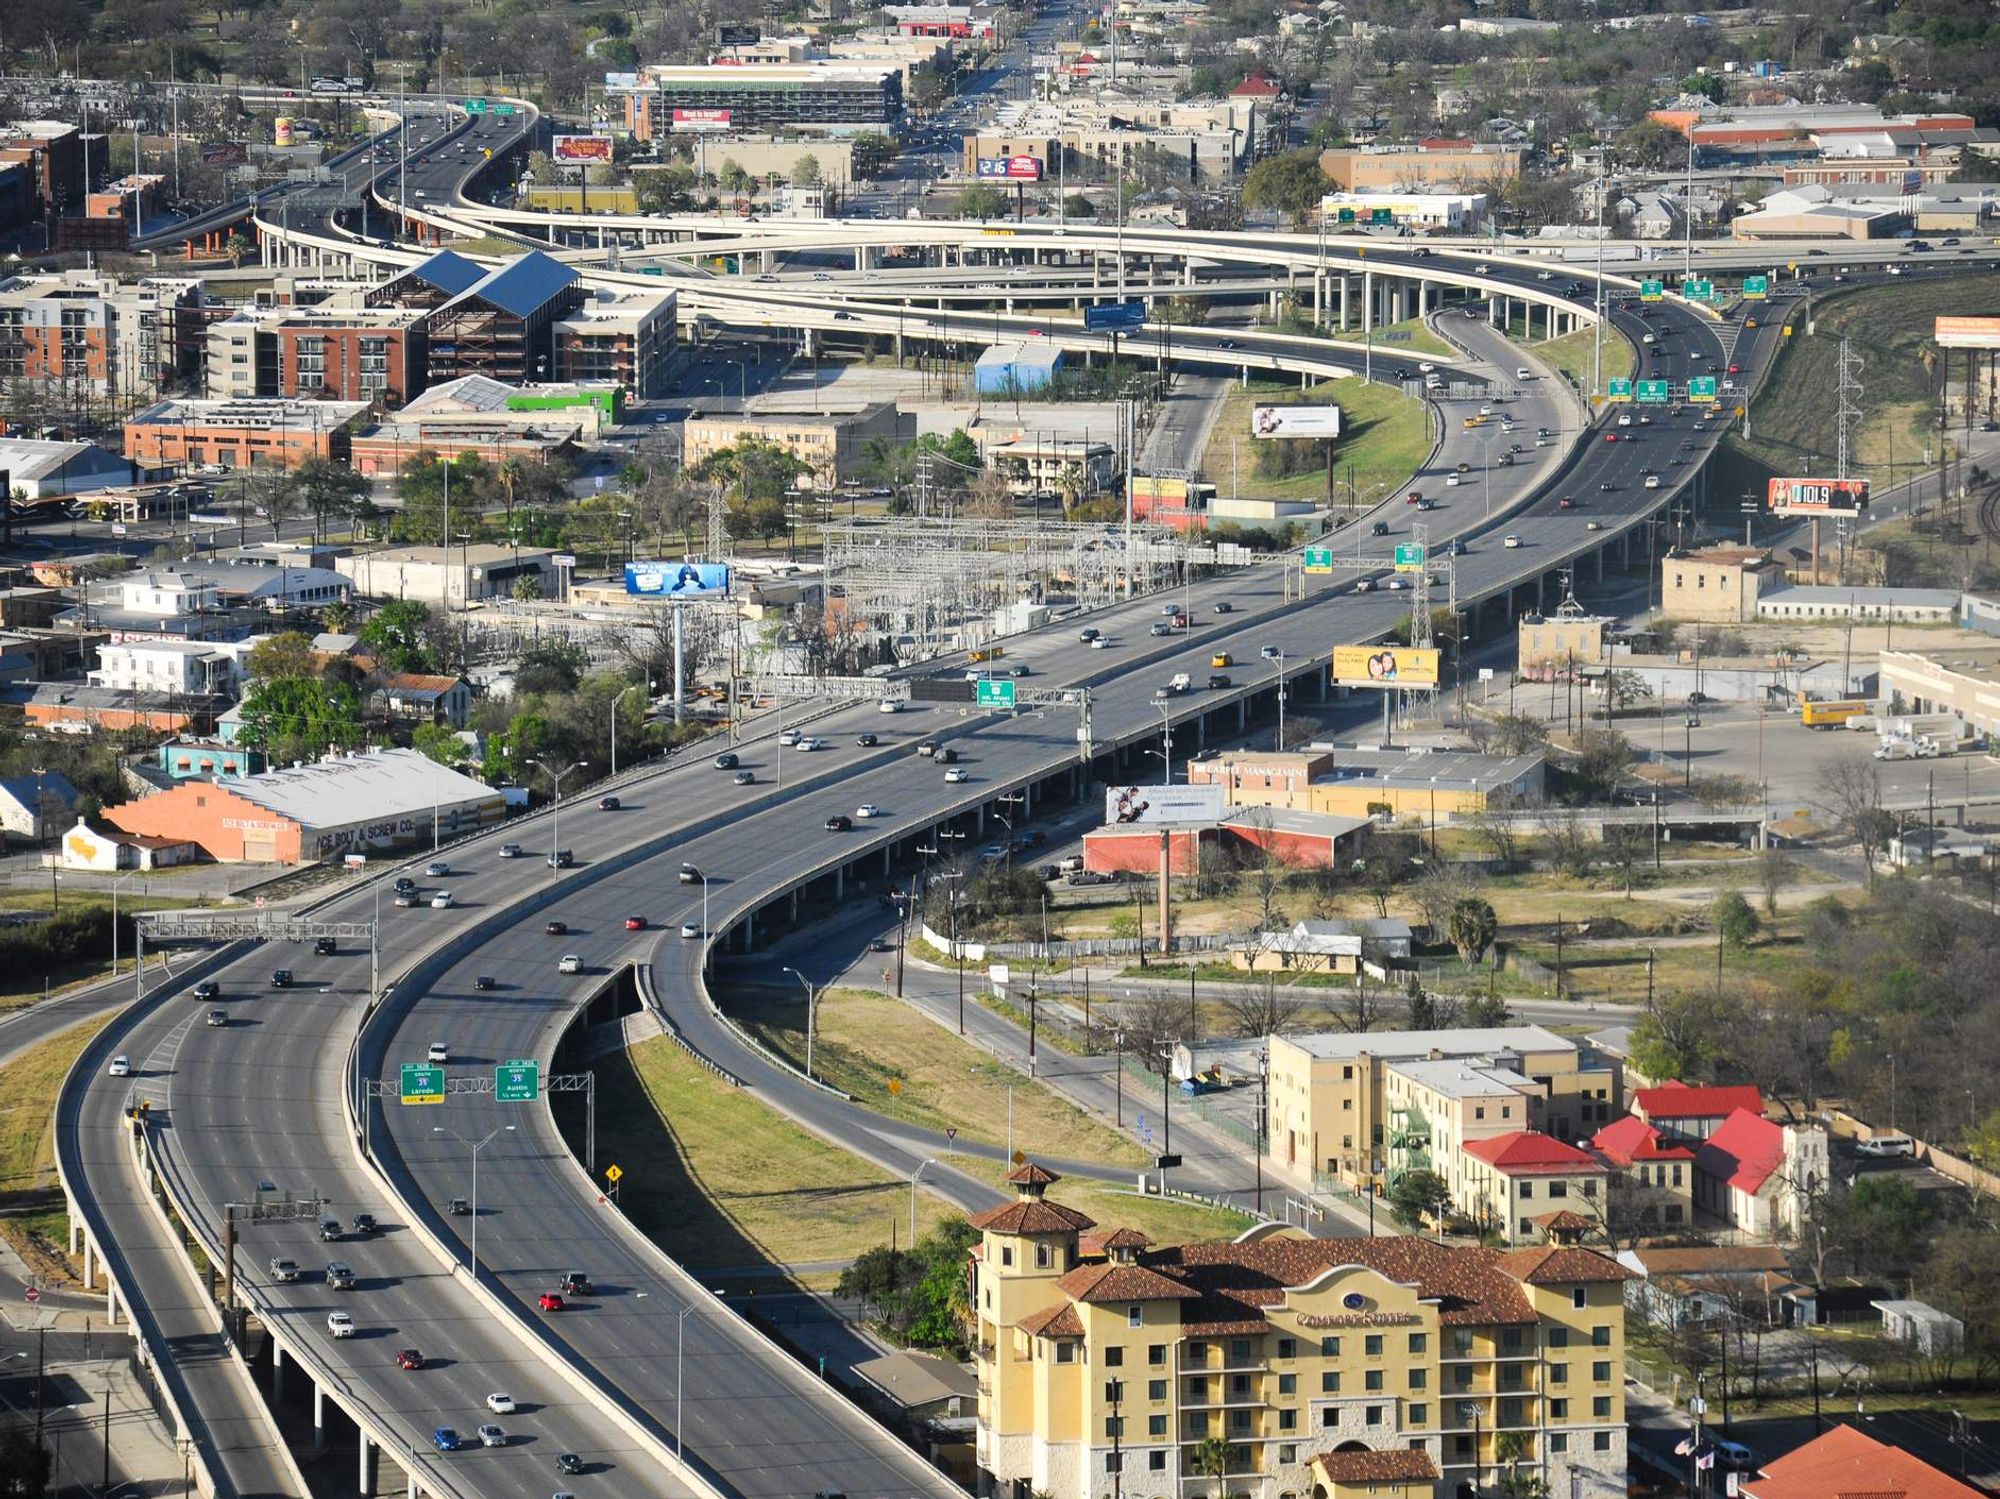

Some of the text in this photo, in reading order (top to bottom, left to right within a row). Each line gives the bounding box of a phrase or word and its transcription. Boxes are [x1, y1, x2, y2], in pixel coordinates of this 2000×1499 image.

[335, 831, 355, 848] BOLT
[359, 829, 366, 842] &
[368, 822, 397, 838] SCREW
[1296, 1310, 1408, 1327] COMFORT SUITES
